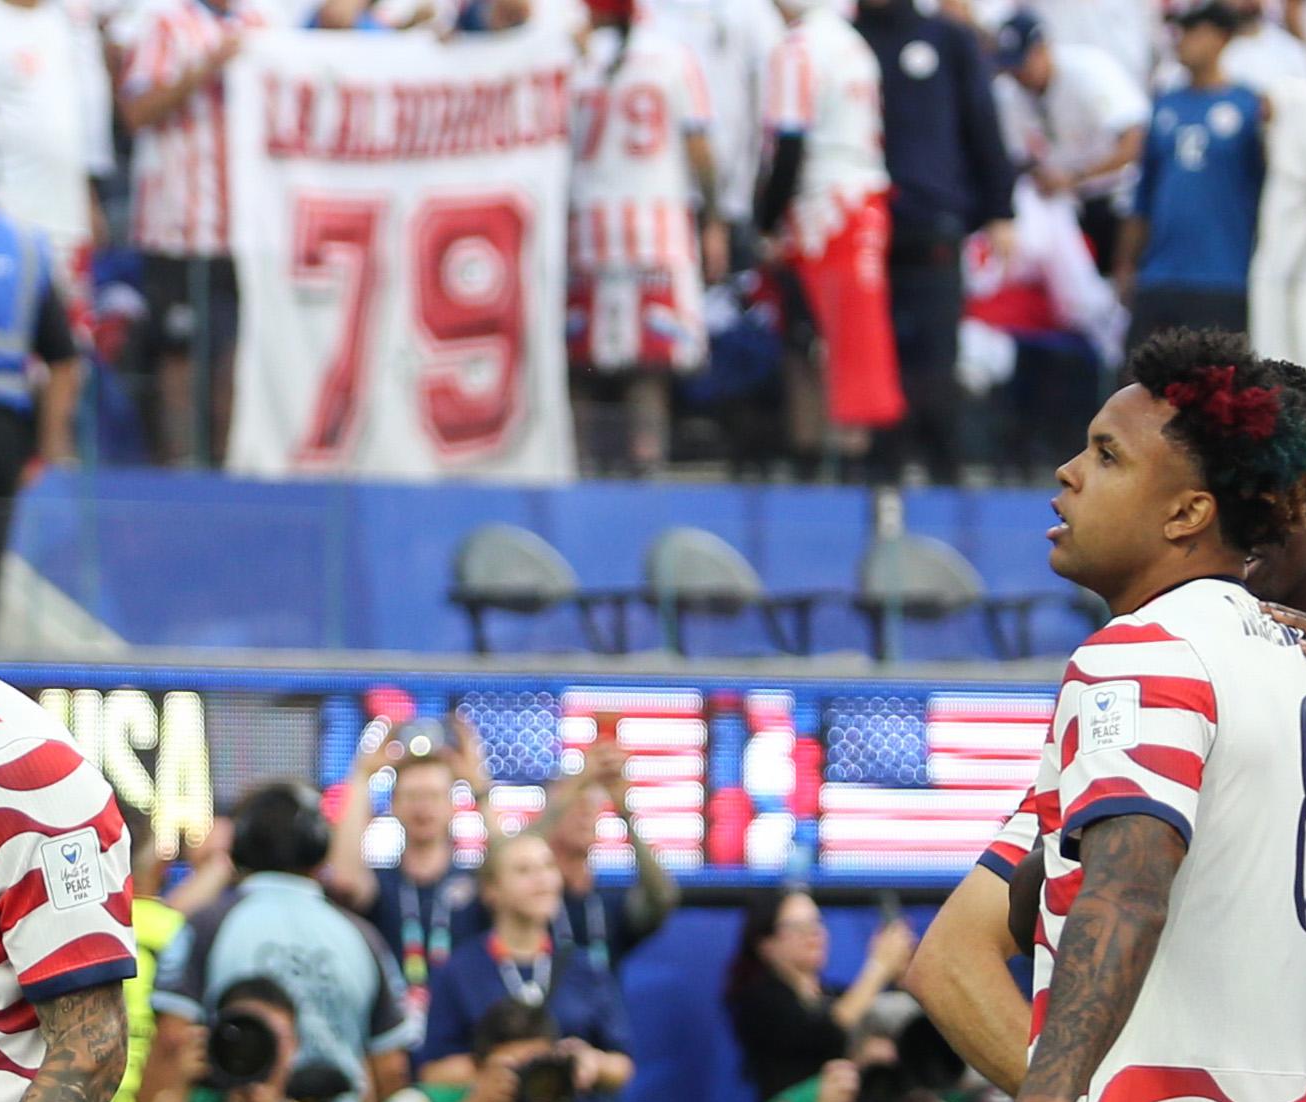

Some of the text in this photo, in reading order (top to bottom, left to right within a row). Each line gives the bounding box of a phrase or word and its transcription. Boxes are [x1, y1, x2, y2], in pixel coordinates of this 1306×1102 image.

[571, 83, 667, 161] 79
[287, 187, 532, 470] 79
[65, 876, 92, 894] PEACE
